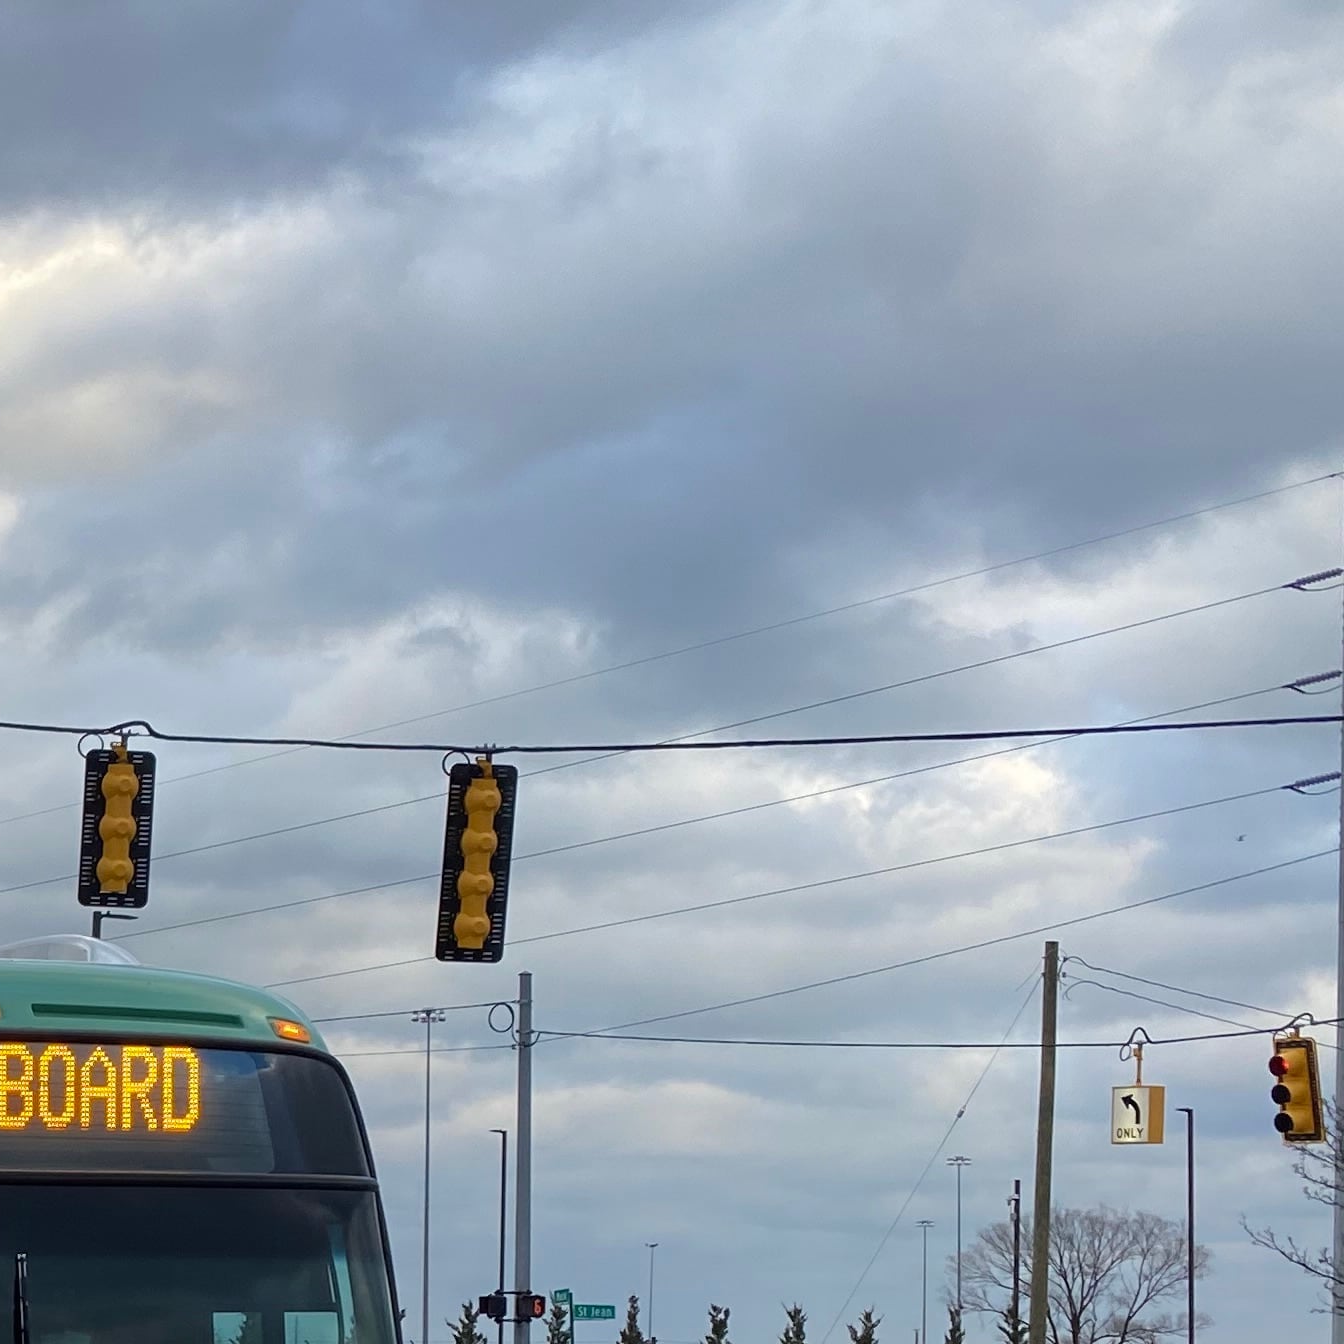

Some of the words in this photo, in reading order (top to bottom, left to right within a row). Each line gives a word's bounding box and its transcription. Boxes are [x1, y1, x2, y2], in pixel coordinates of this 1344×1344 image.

[1116, 1127, 1144, 1139] ONLY
[577, 1305, 587, 1317] St
[591, 1306, 614, 1317] Jean
